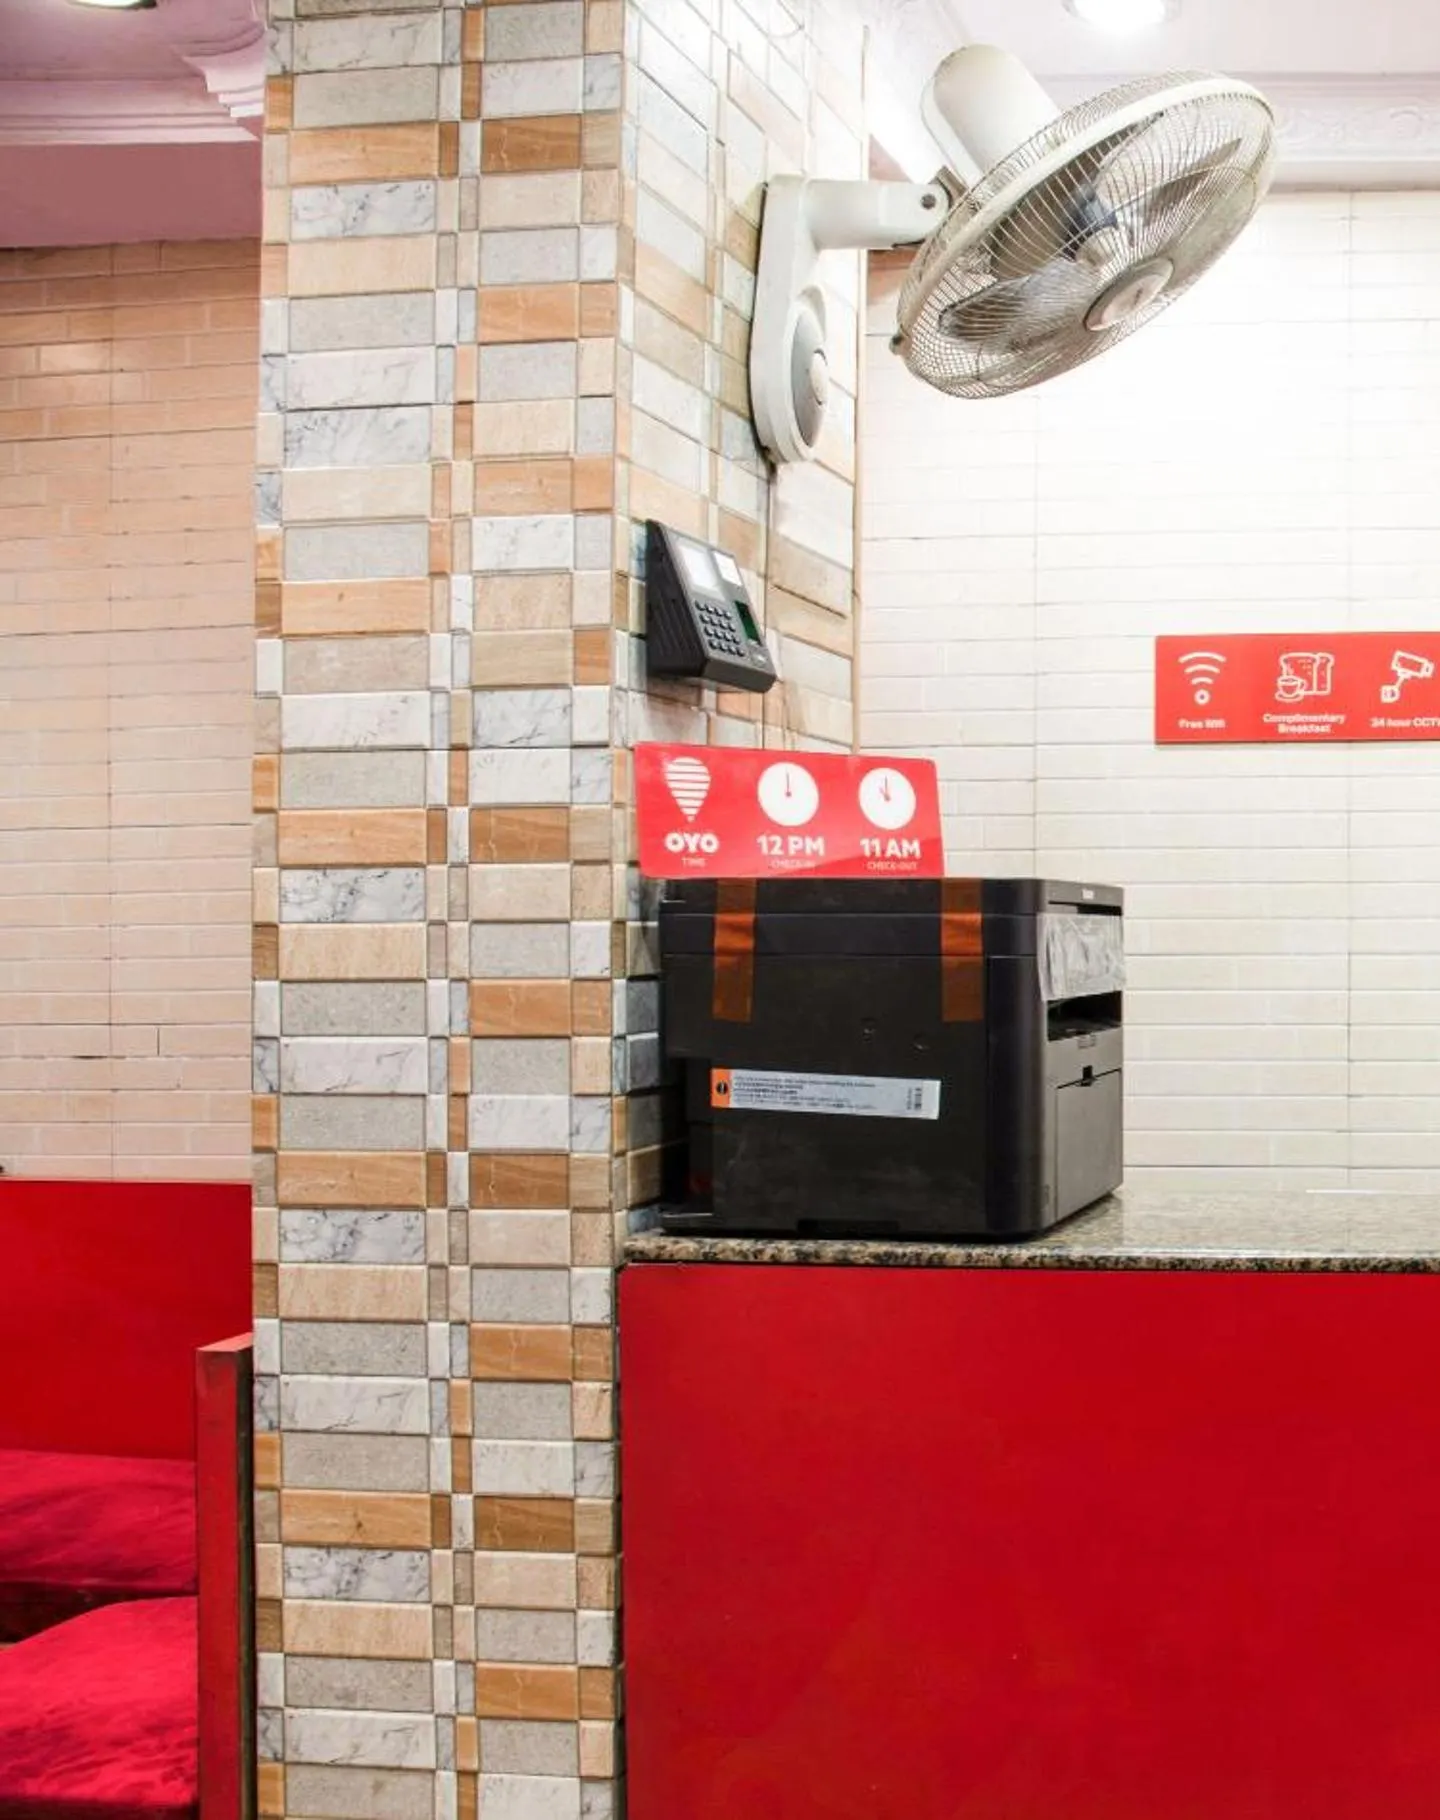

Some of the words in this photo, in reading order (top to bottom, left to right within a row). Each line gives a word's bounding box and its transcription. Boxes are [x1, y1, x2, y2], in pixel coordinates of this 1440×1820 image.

[664, 832, 719, 853] OYO
[757, 835, 784, 855] 12
[788, 836, 825, 857] PM
[860, 838, 881, 857] 11
[885, 838, 921, 859] AM
